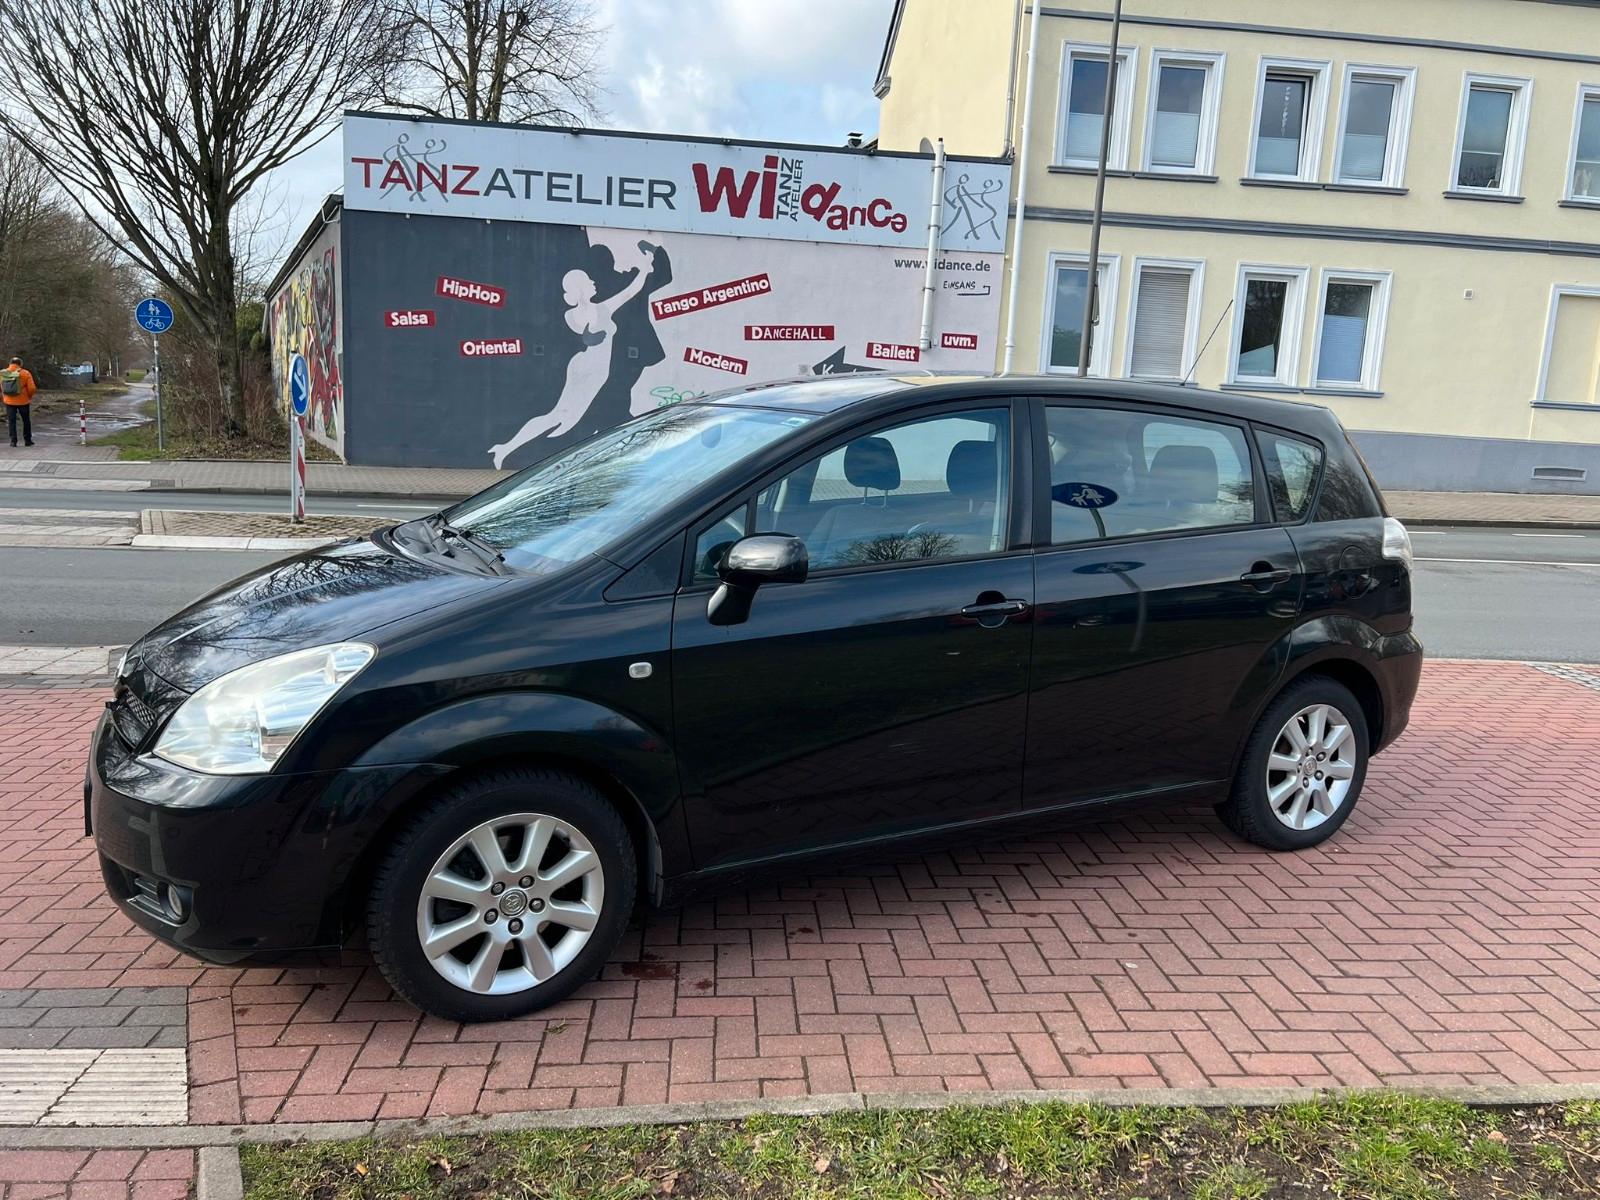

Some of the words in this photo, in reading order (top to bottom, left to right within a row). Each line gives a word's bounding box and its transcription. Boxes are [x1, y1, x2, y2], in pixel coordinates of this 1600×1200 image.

[776, 157, 794, 220] TANZ
[789, 159, 804, 222] ATELIER
[894, 257, 991, 272] www.idance.de
[442, 278, 501, 304] HipHop
[654, 295, 699, 316] Tango
[702, 276, 770, 304] Argentino
[391, 312, 428, 326] Salsa
[751, 326, 826, 340] DANCEHALL
[463, 339, 521, 356] Oriental
[943, 336, 975, 348] uvm.
[872, 343, 916, 360] Ballett
[689, 348, 743, 374] Modern
